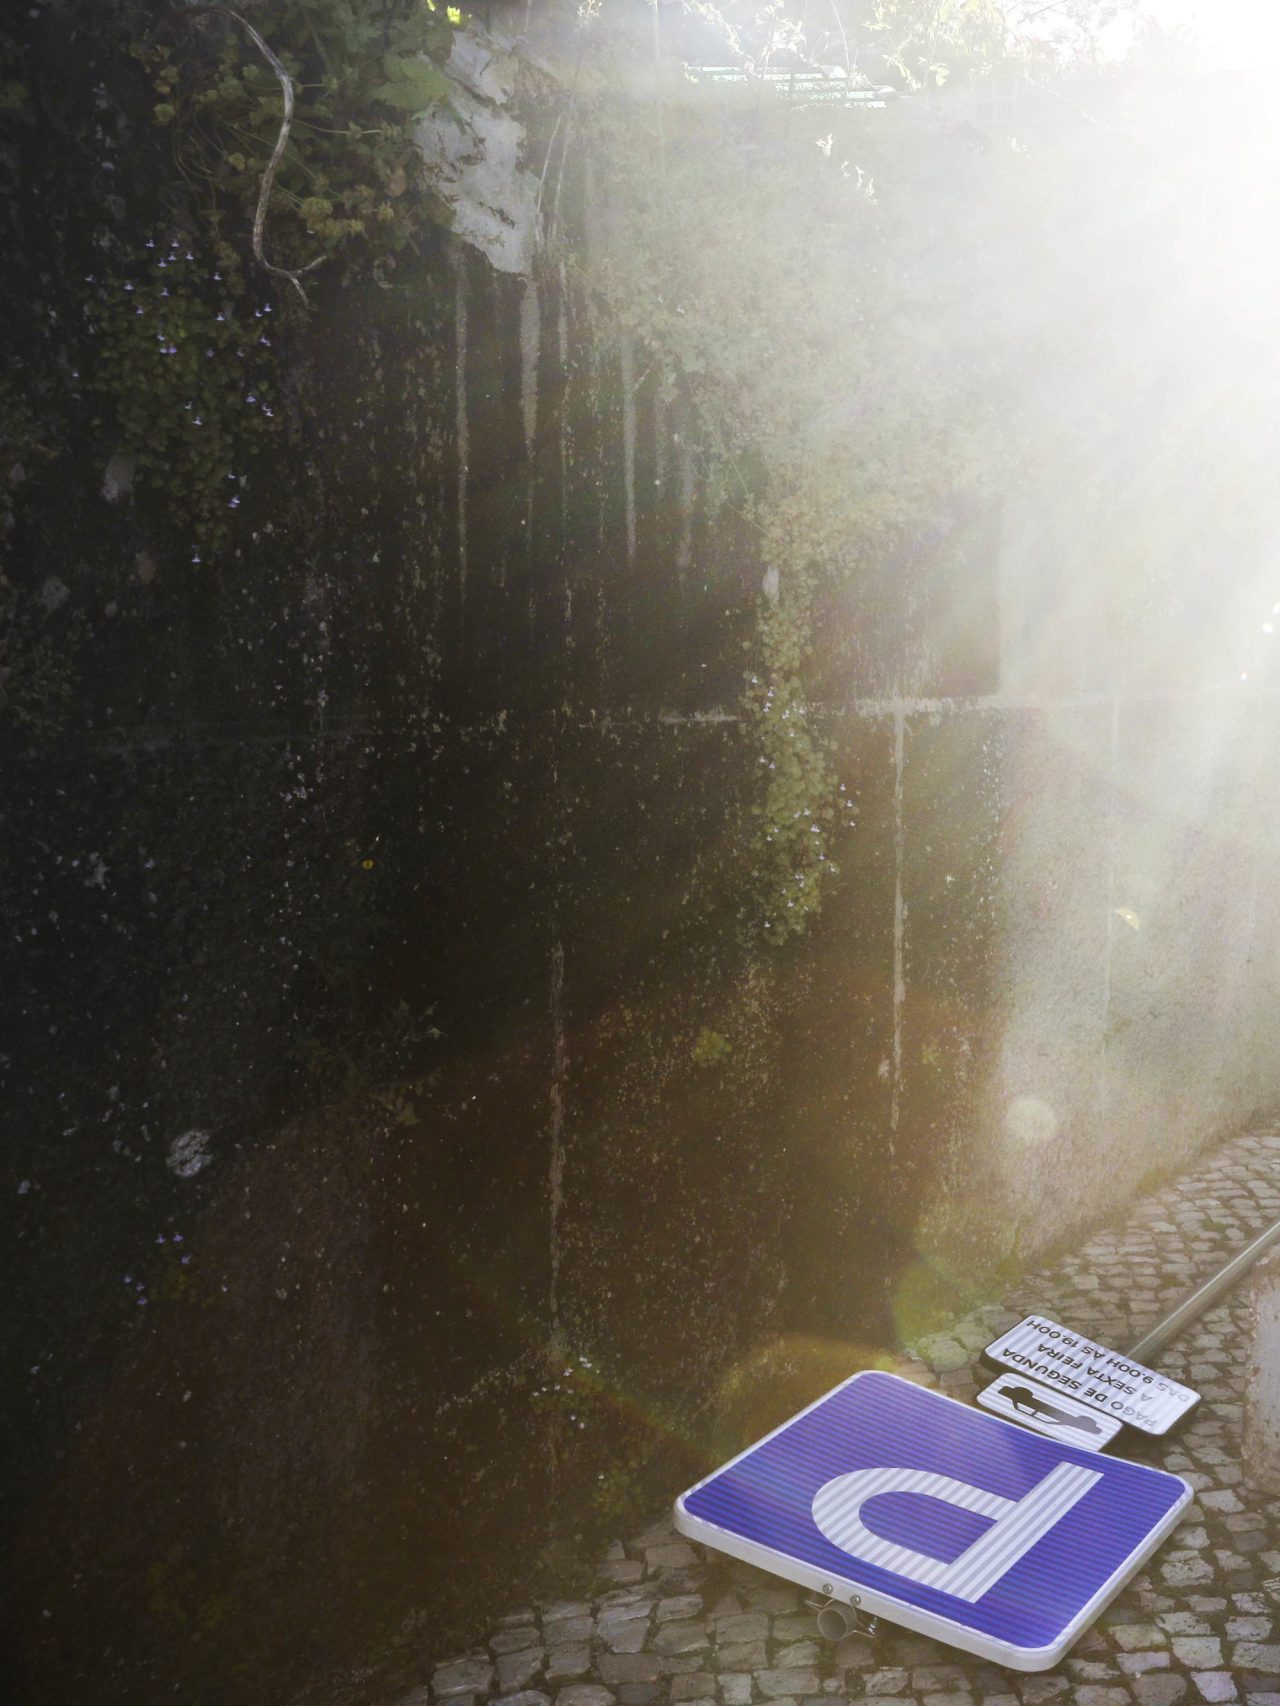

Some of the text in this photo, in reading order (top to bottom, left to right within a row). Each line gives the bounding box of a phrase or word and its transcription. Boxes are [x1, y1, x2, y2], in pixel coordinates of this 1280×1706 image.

[1026, 1319, 1079, 1348] 19.00H
[1002, 1347, 1158, 1428] PAGO DE SEGUNDA
[1037, 1343, 1153, 1402] A SEXTA FEIRA
[1106, 1357, 1154, 1384] 9.00H
[1156, 1382, 1191, 1403] DAS
[811, 1461, 1105, 1604] P
